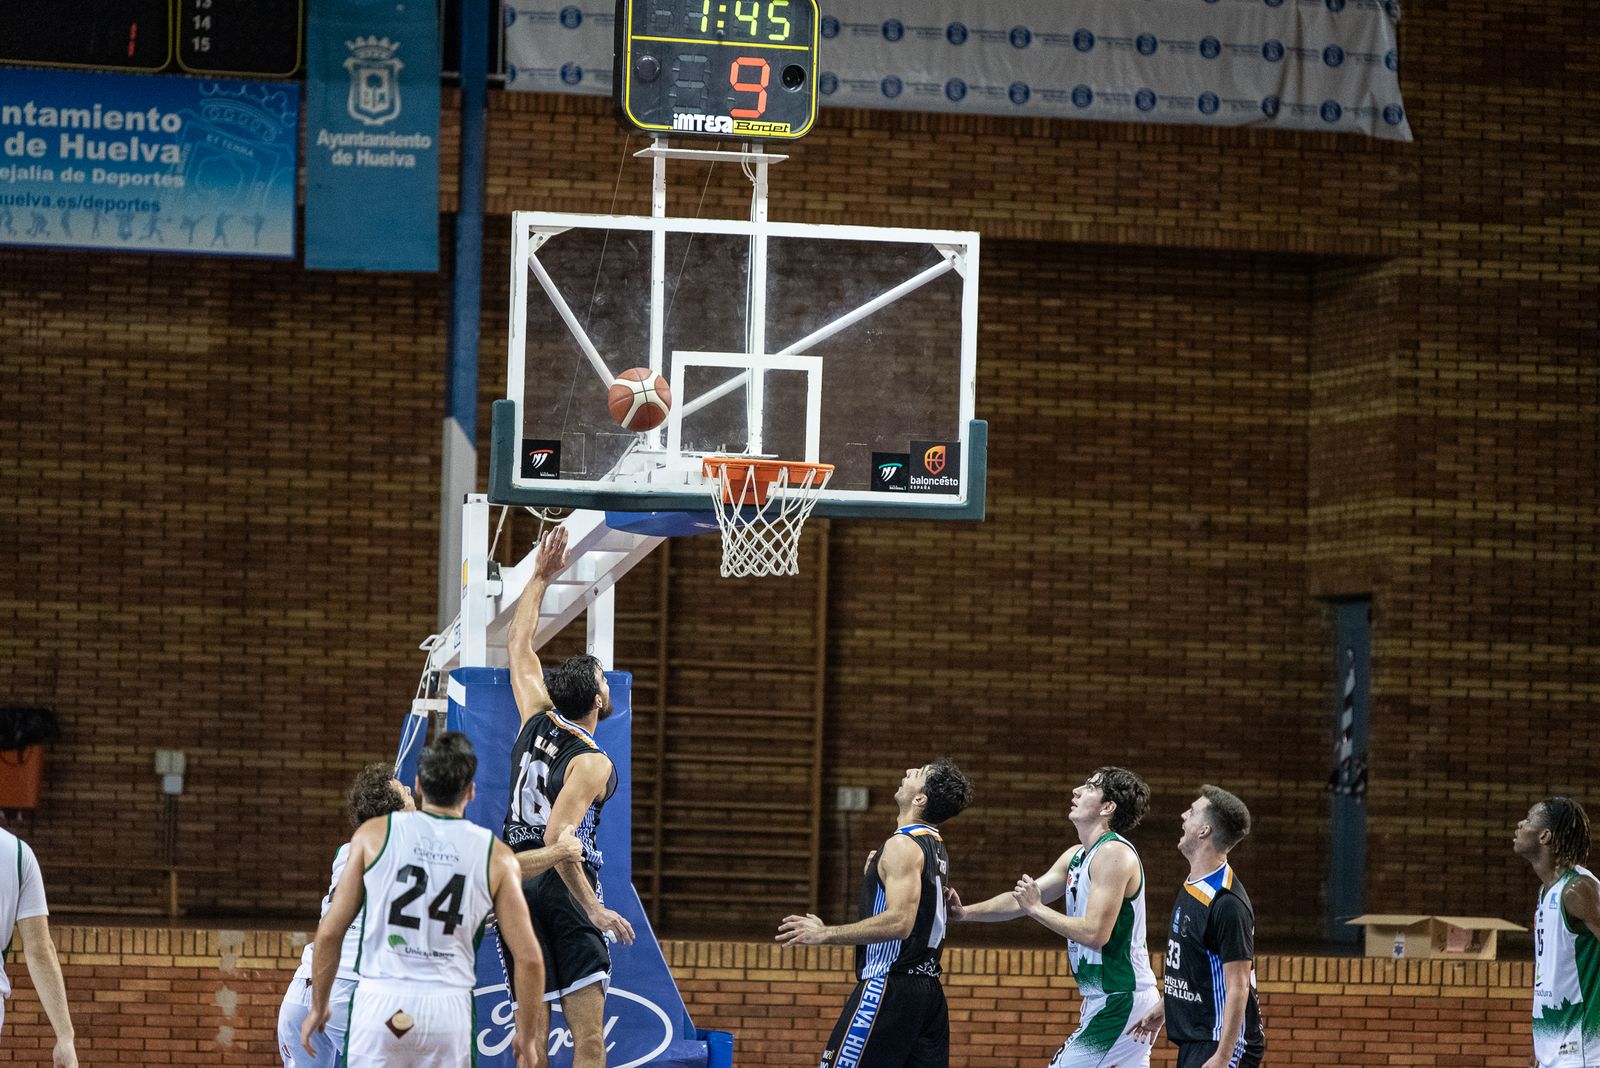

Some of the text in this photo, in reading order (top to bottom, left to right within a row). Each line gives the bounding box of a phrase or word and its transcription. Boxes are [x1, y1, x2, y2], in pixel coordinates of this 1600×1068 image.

[192, 15, 211, 30] 14
[700, 0, 790, 41] 1:45
[191, 36, 210, 51] 15
[730, 57, 770, 118] 9
[1, 101, 182, 133] ntamiento
[4, 131, 47, 157] de
[59, 133, 181, 163] Huelva
[316, 129, 432, 148] Ayuntamiento
[331, 150, 416, 167] de Huelva
[60, 167, 85, 183] de
[92, 168, 185, 189] Deportes
[910, 475, 959, 486] baloncesto
[388, 864, 467, 935] 24
[1166, 938, 1181, 970] 33
